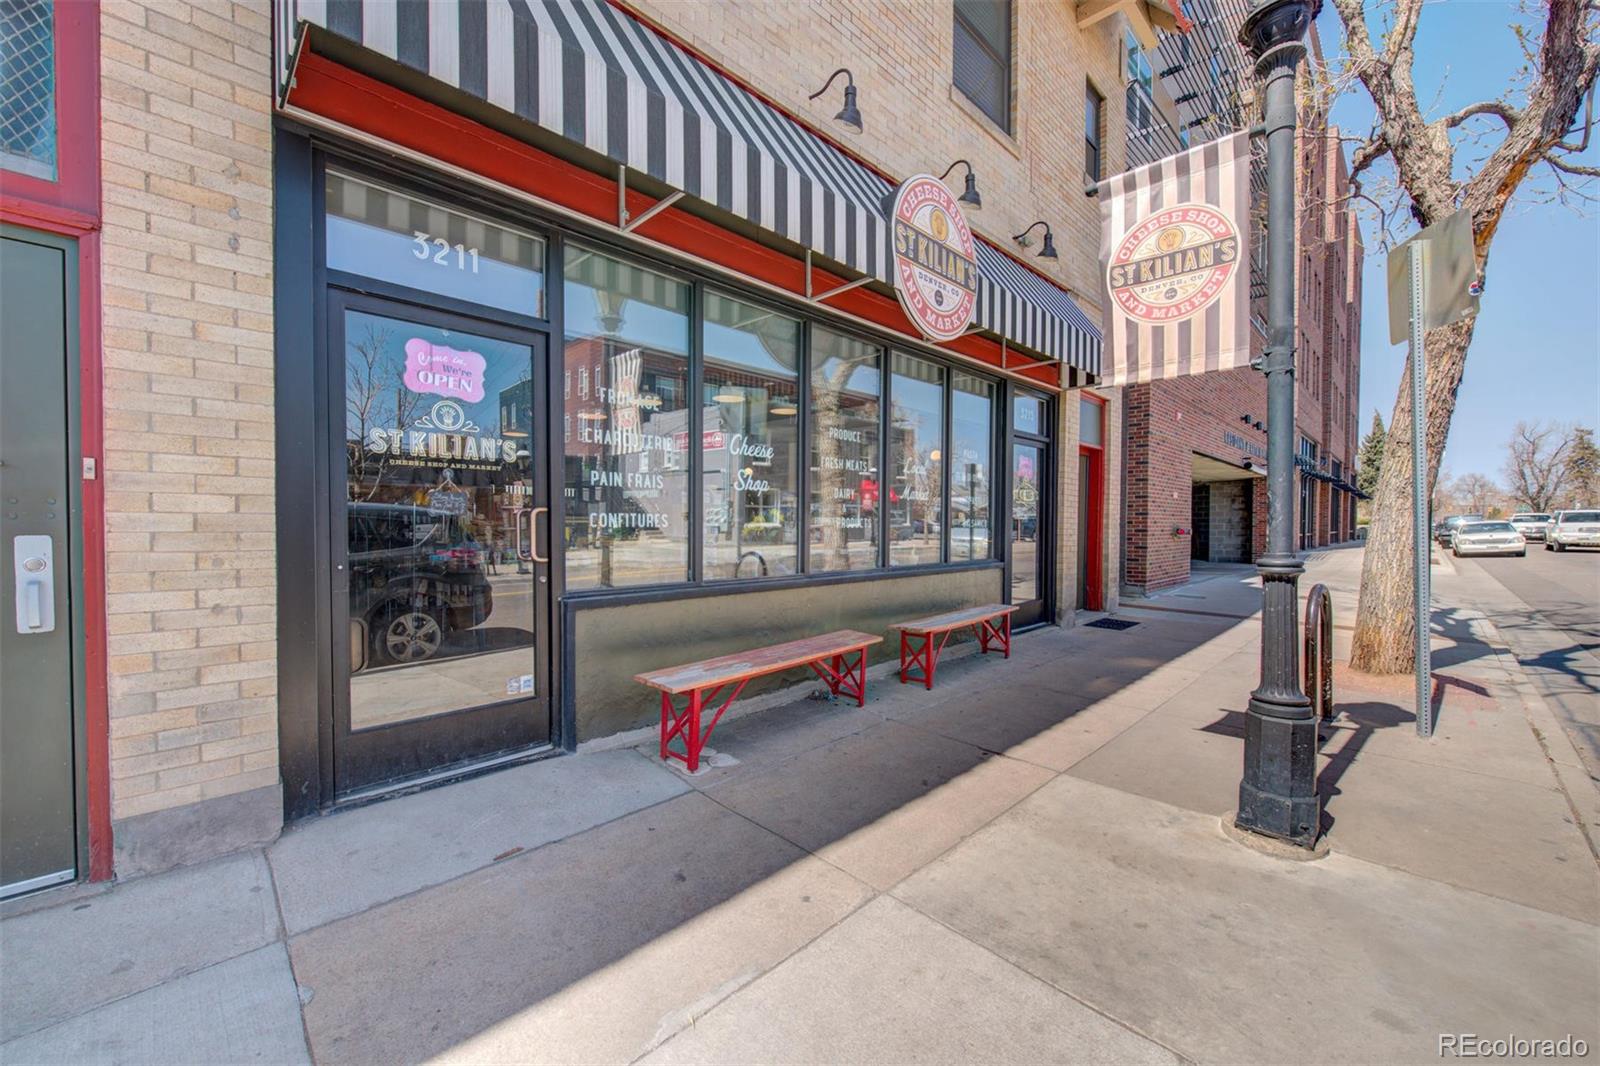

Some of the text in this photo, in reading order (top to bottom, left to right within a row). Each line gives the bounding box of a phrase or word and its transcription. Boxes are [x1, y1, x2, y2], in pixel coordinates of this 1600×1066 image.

[903, 185, 973, 254] CHEESE SHOP
[1119, 210, 1226, 259] CHEESE SHOP
[412, 231, 479, 273] 3211
[918, 235, 976, 290] KILIAN'S
[1139, 239, 1235, 282] KILIAN'S
[1190, 274, 1204, 282] CO
[901, 264, 923, 308] AND
[925, 296, 971, 331] MARKET
[1118, 270, 1225, 318] AND MARKET
[417, 371, 473, 393] OPEN
[409, 431, 518, 463] KILIAN'S
[729, 433, 774, 460] Cheese
[829, 427, 861, 443] PRODUCE
[590, 470, 664, 488] PAIN FRAIS
[846, 459, 868, 472] MEATS
[734, 469, 770, 496] Shop
[834, 488, 856, 500] DAIRY
[589, 512, 669, 528] CONFITURES
